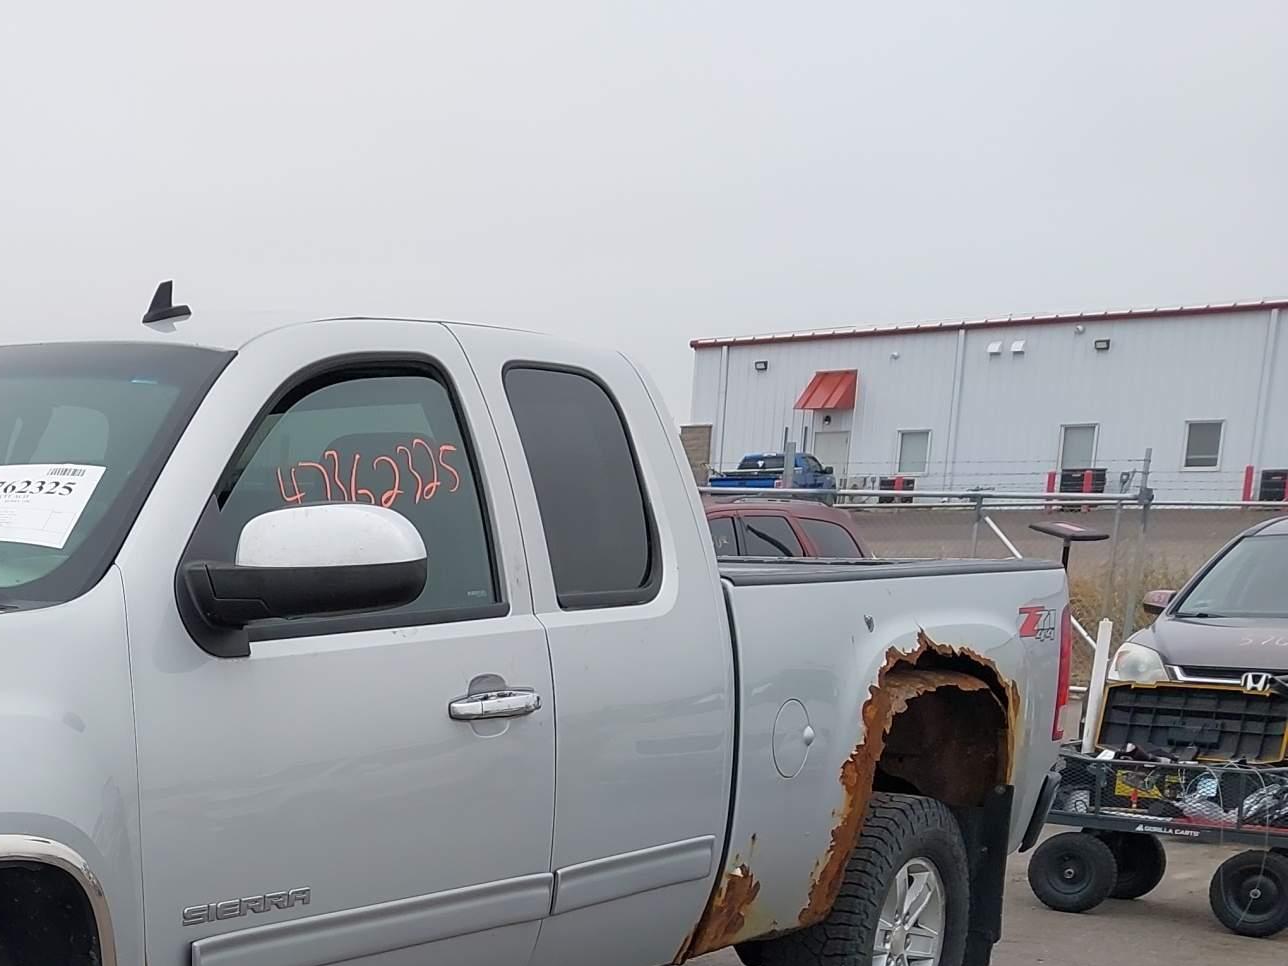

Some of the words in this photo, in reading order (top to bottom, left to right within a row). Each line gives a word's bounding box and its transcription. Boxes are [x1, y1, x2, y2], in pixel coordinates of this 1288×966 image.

[1018, 605, 1057, 639] Z71
[1144, 825, 1173, 835] GORILLA
[1174, 828, 1201, 837] CARTS
[182, 886, 311, 927] SIERRA
